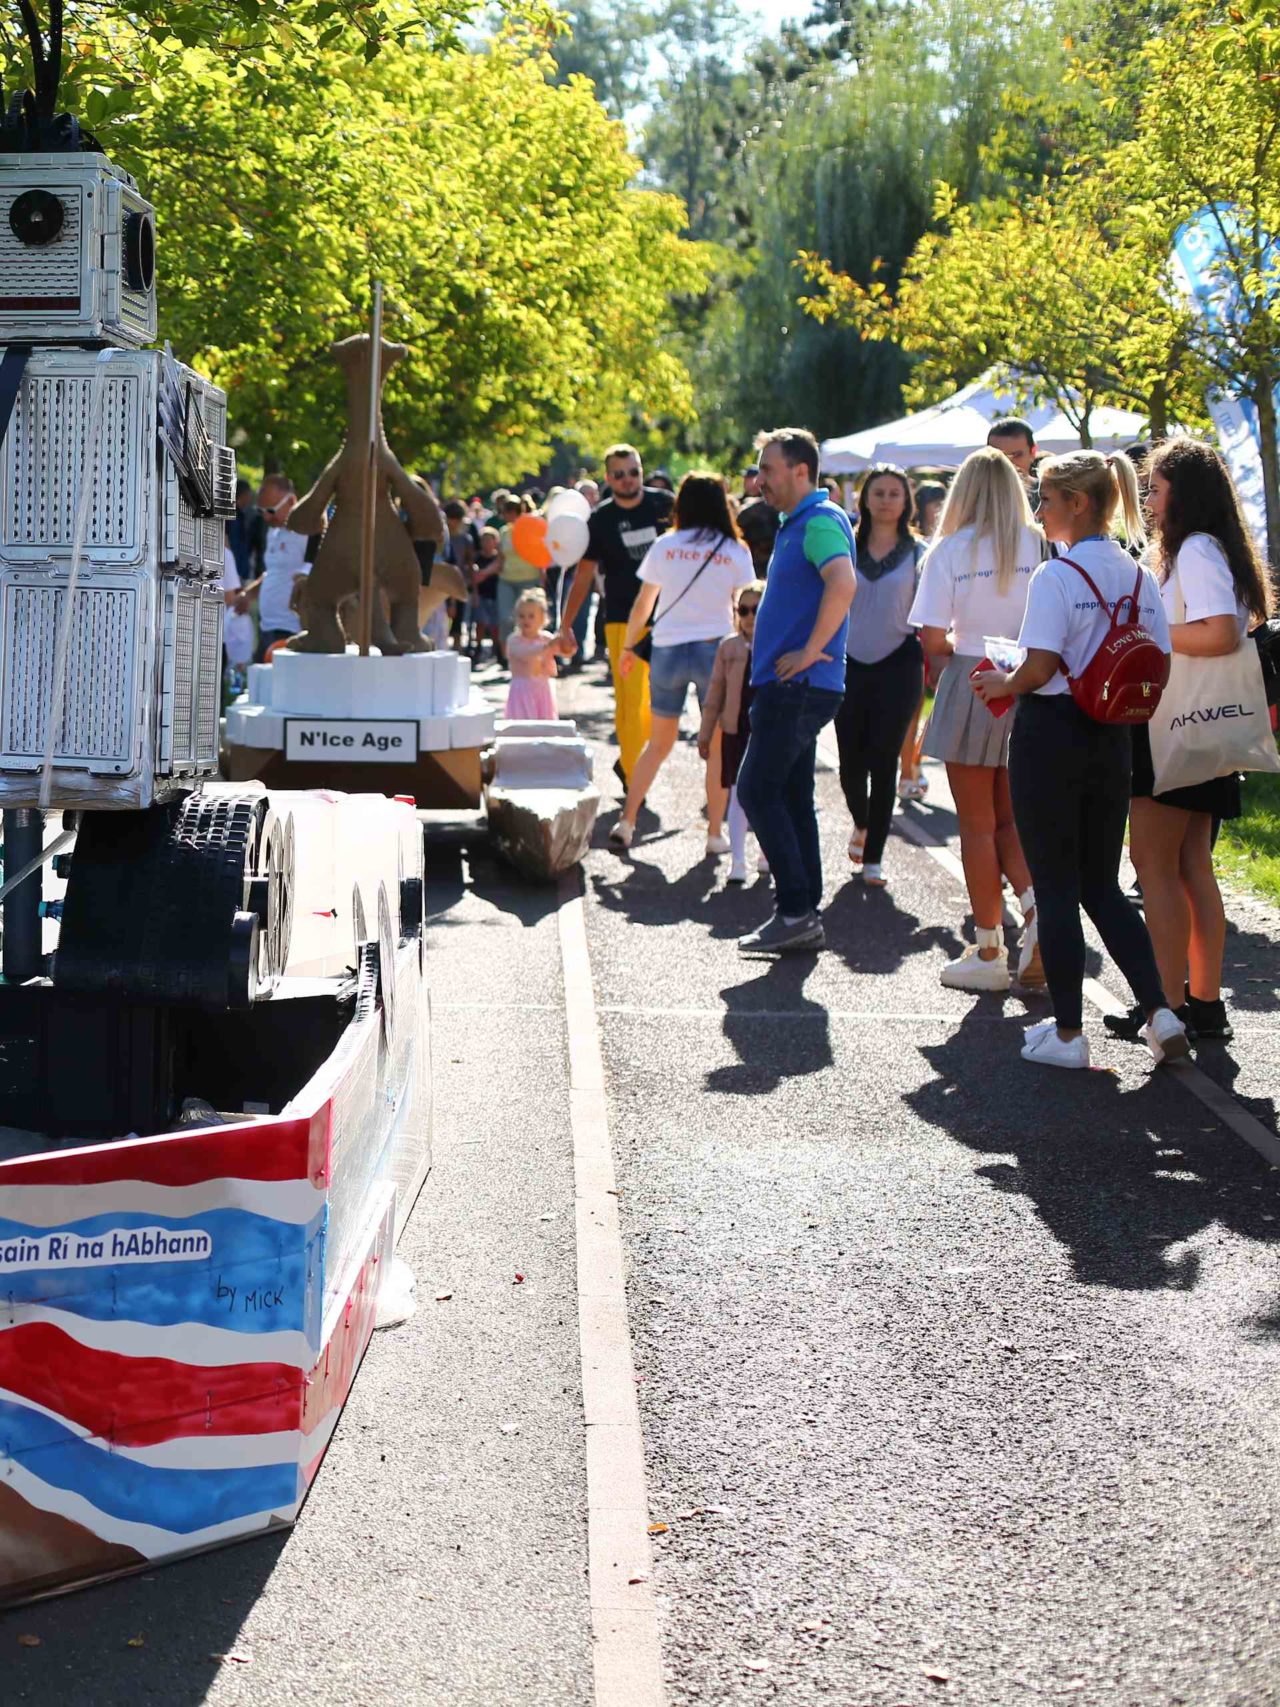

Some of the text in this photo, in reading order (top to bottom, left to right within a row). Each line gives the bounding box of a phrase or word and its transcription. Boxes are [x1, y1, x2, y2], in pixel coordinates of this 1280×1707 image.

[1170, 704, 1255, 731] AKWEL
[300, 731, 403, 751] N'Ice Age
[48, 1234, 69, 1261] Rí
[76, 1241, 103, 1259] na
[112, 1231, 209, 1258] hAbhann
[217, 1274, 237, 1312] by
